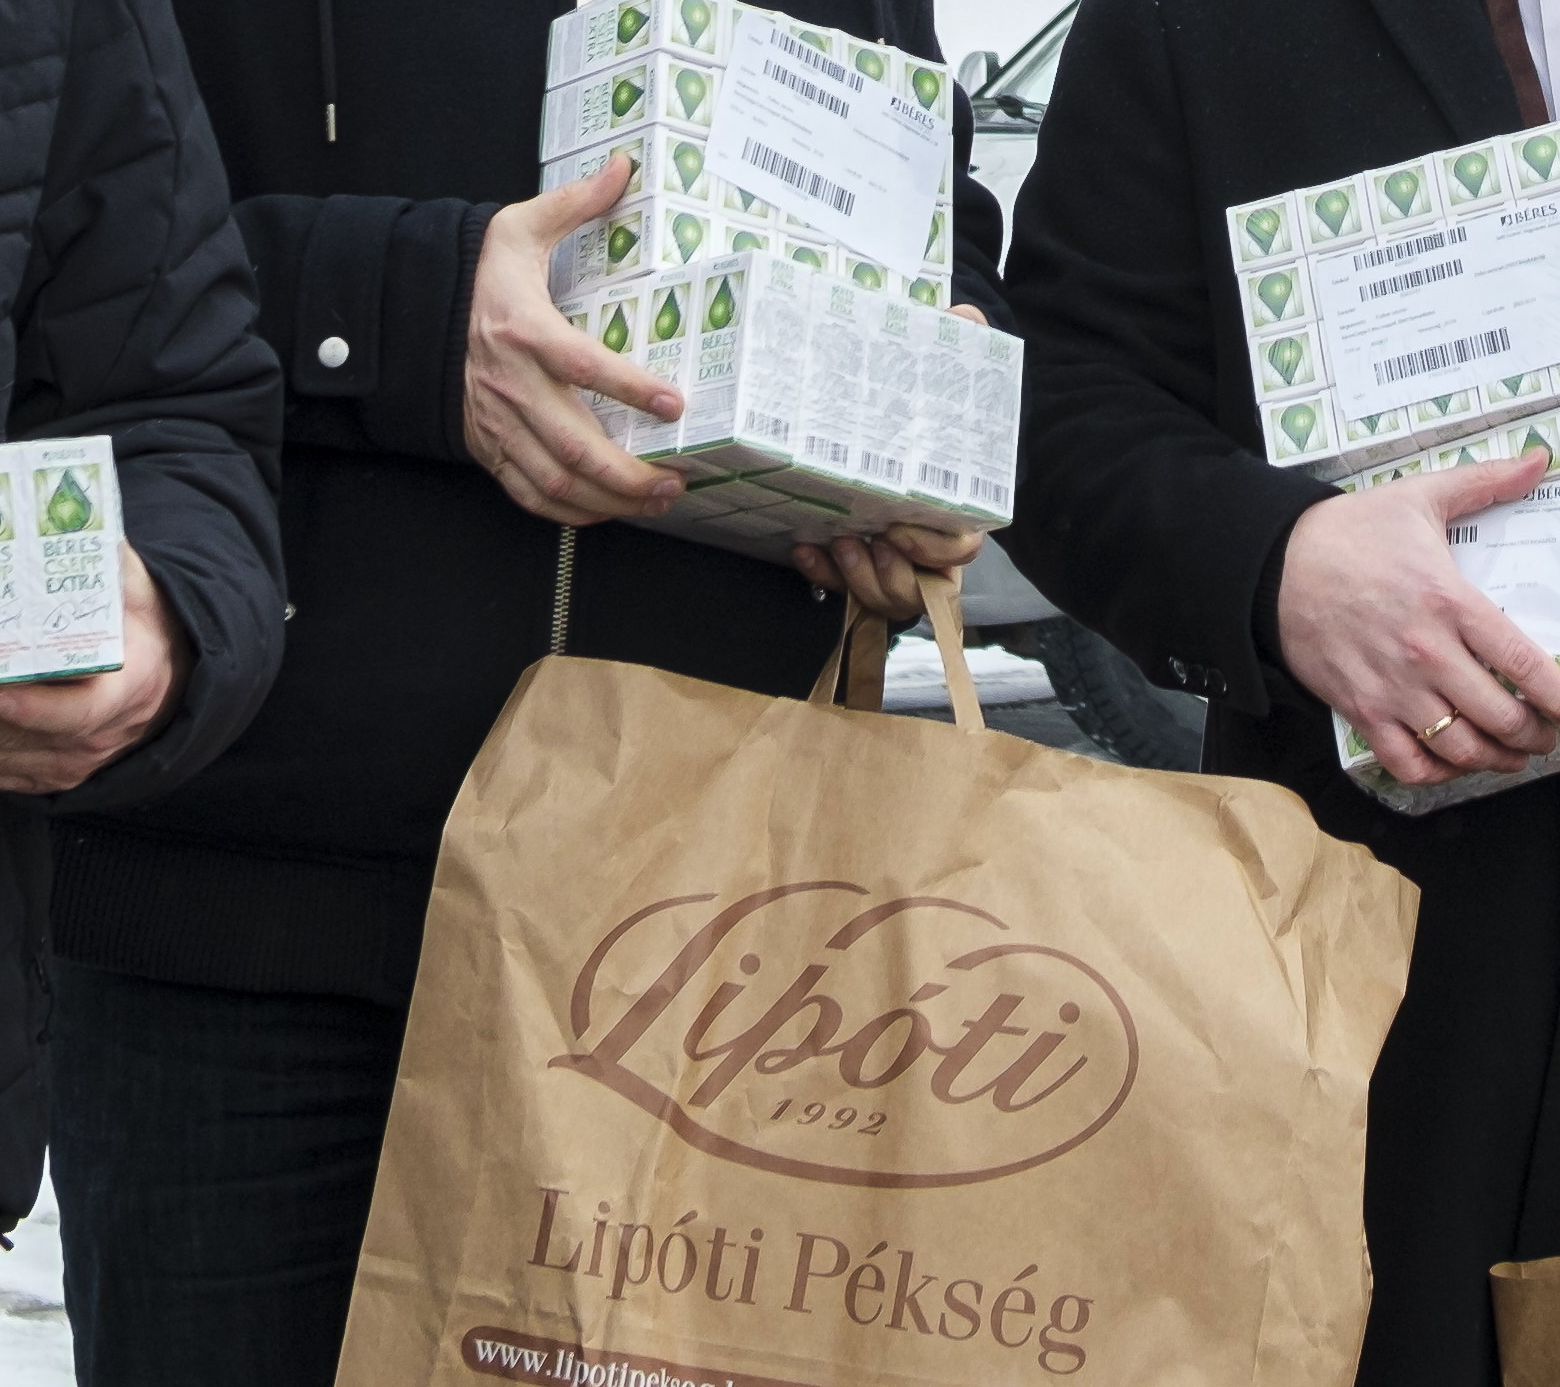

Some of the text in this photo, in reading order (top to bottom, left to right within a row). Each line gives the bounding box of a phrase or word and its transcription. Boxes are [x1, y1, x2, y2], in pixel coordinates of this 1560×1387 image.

[901, 102, 935, 131] BÉRES
[1515, 203, 1558, 224] BÉRES
[43, 536, 102, 558] BÉRES
[46, 572, 105, 595] EXTRA
[547, 880, 1090, 1112] Lipóti
[768, 1097, 889, 1136] 1992
[526, 1187, 1094, 1376] Lipóti Pékség
